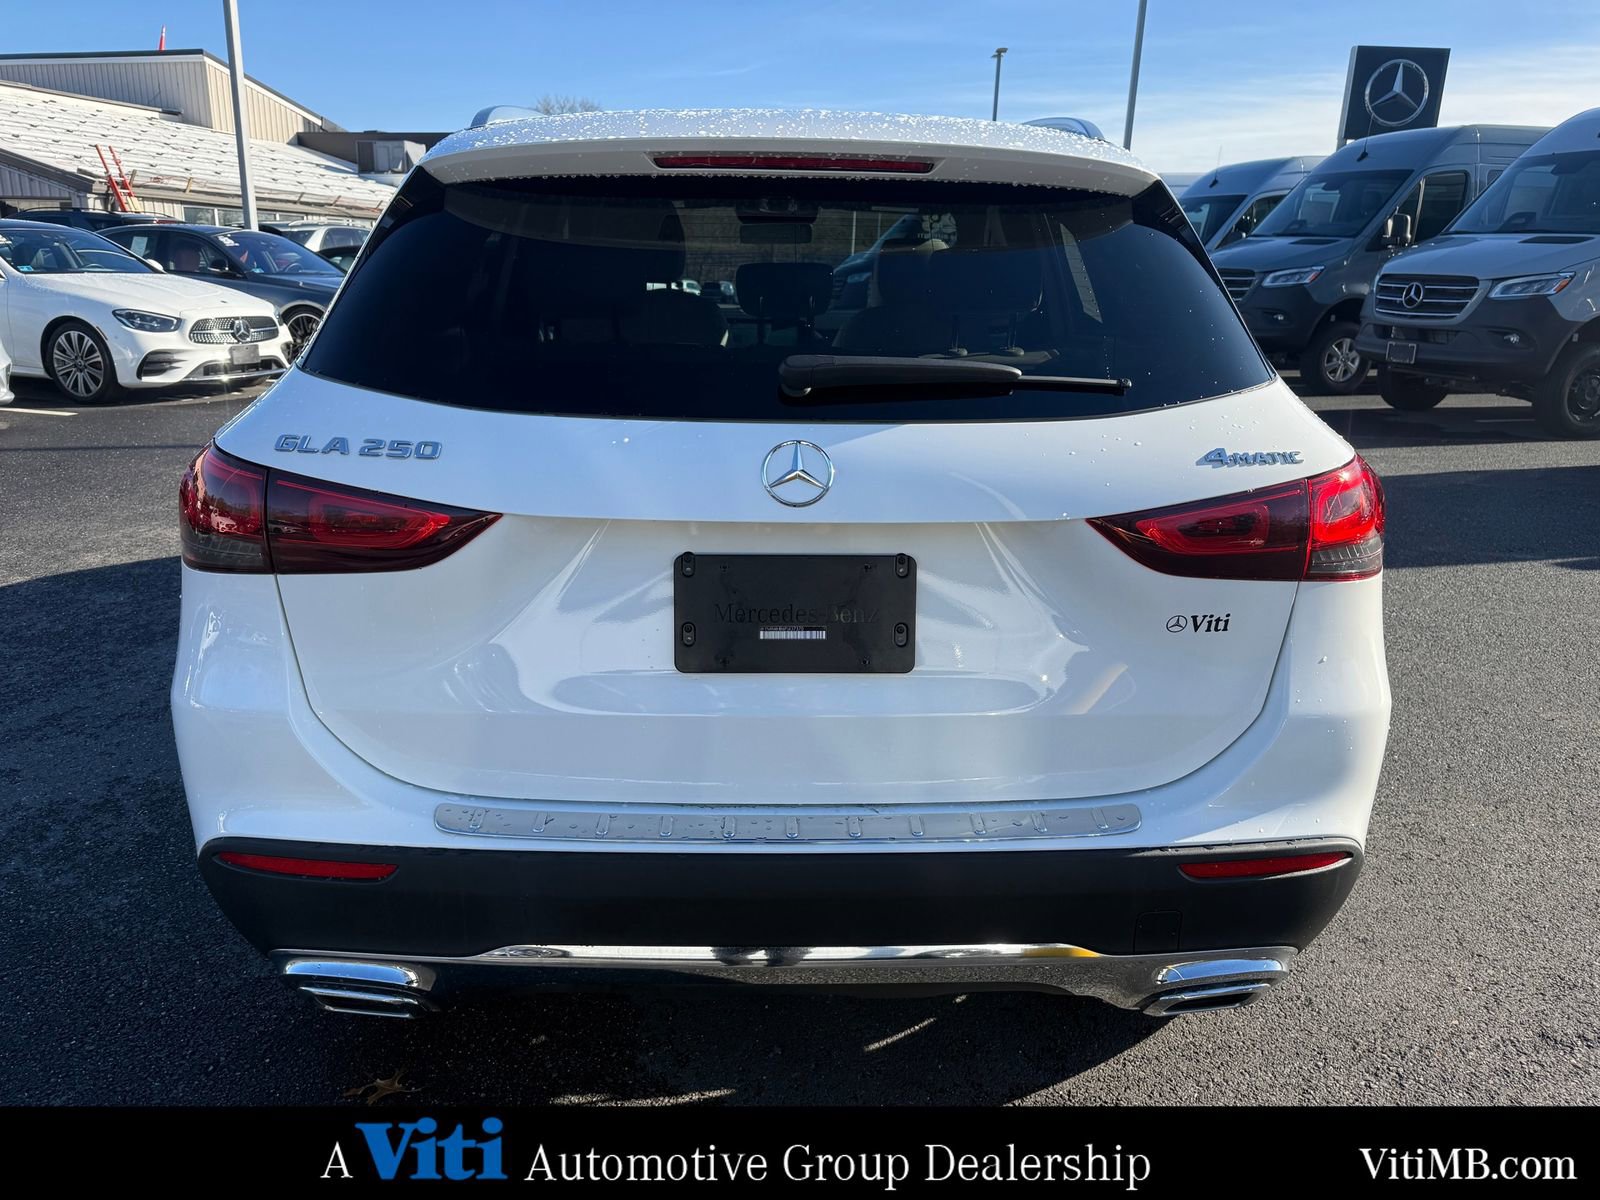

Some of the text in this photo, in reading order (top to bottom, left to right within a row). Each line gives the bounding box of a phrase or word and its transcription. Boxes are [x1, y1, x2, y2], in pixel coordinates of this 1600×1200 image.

[274, 434, 443, 459] GLA 250
[1195, 447, 1304, 469] 4MATIC
[714, 603, 880, 624] Mercedes-Benz
[1190, 613, 1231, 633] Viti
